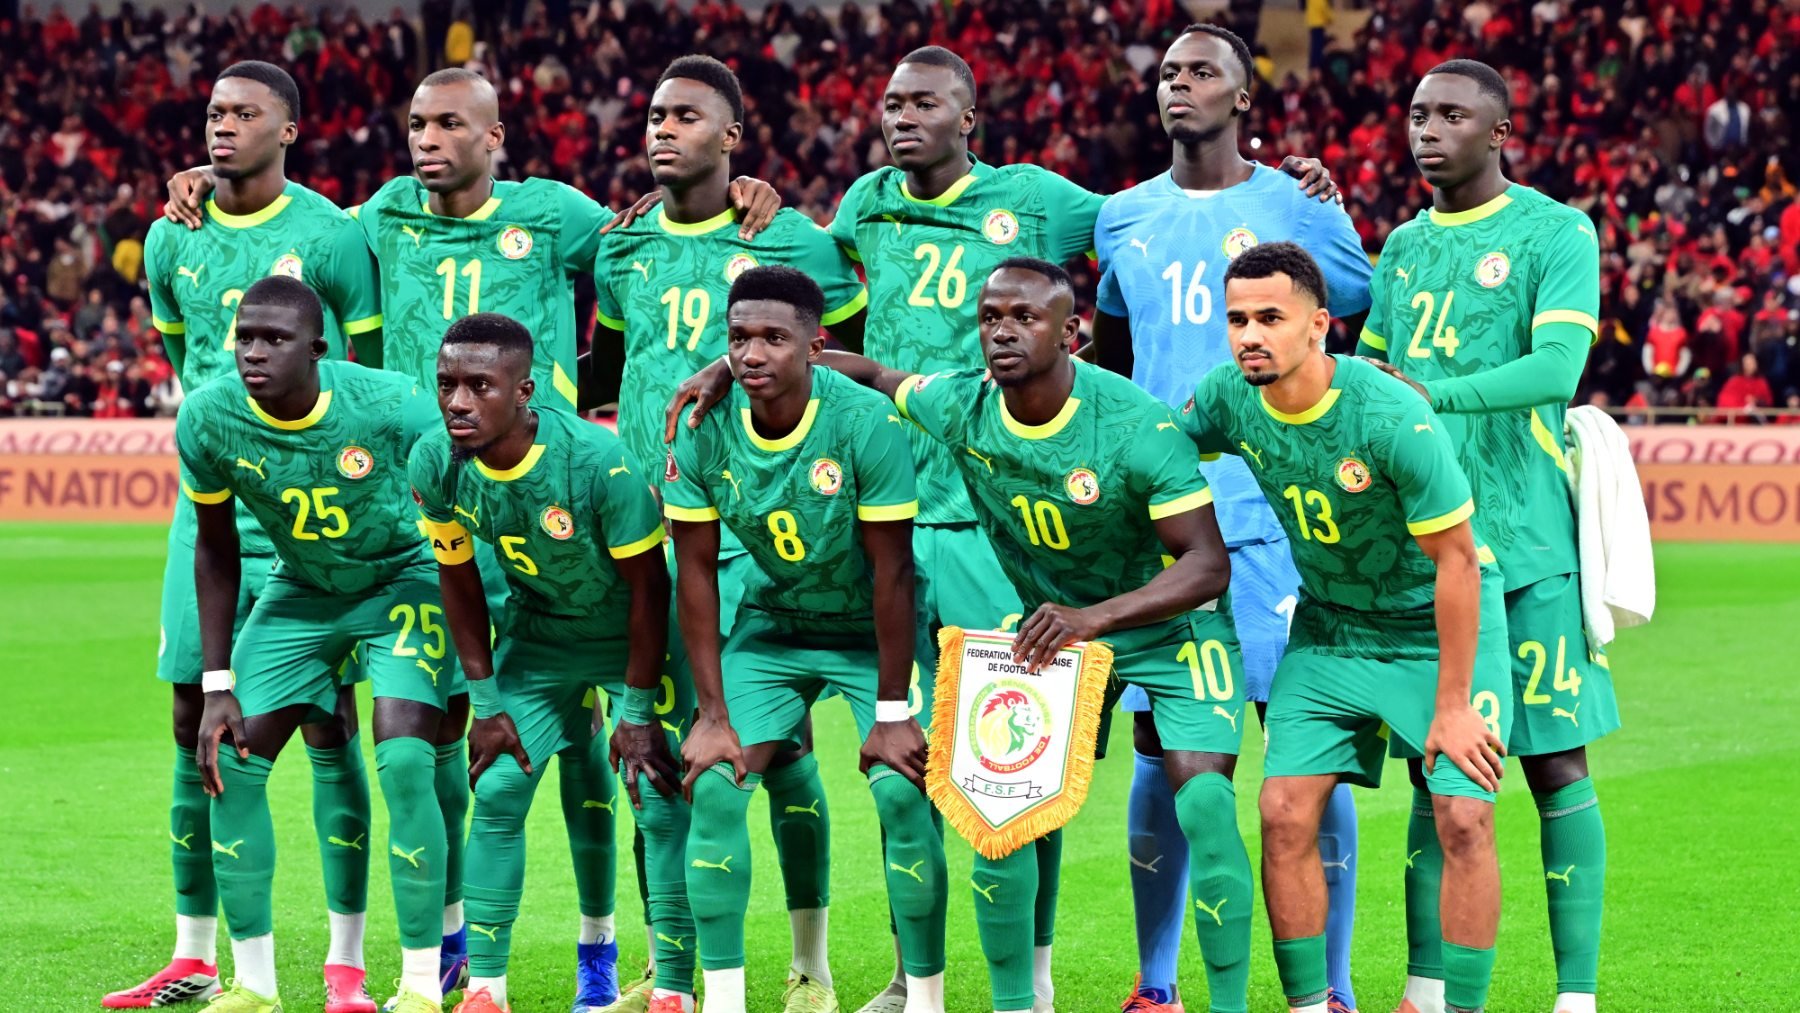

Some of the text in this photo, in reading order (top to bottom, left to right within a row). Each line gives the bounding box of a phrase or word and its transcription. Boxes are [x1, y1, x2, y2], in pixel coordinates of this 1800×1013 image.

[436, 257, 482, 320] 11
[908, 244, 967, 309] 26
[1161, 260, 1212, 325] 16
[660, 286, 710, 351] 19
[1408, 291, 1460, 358] 24
[1631, 436, 1800, 463] ORO
[281, 487, 349, 540] 25
[1011, 495, 1071, 550] 10
[1284, 486, 1340, 544] 13
[1696, 481, 1800, 525] MO
[500, 535, 539, 576] 5
[767, 510, 805, 562] 8
[389, 603, 447, 658] 25
[1275, 594, 1297, 645] 1
[967, 648, 1012, 660] FEDERATION
[988, 662, 998, 672] DE
[1176, 640, 1234, 700] 10
[1518, 635, 1582, 705] 24
[1472, 690, 1500, 753] 3
[984, 783, 1016, 796] F.S.F
[988, 755, 1035, 772] FOOTBALL
